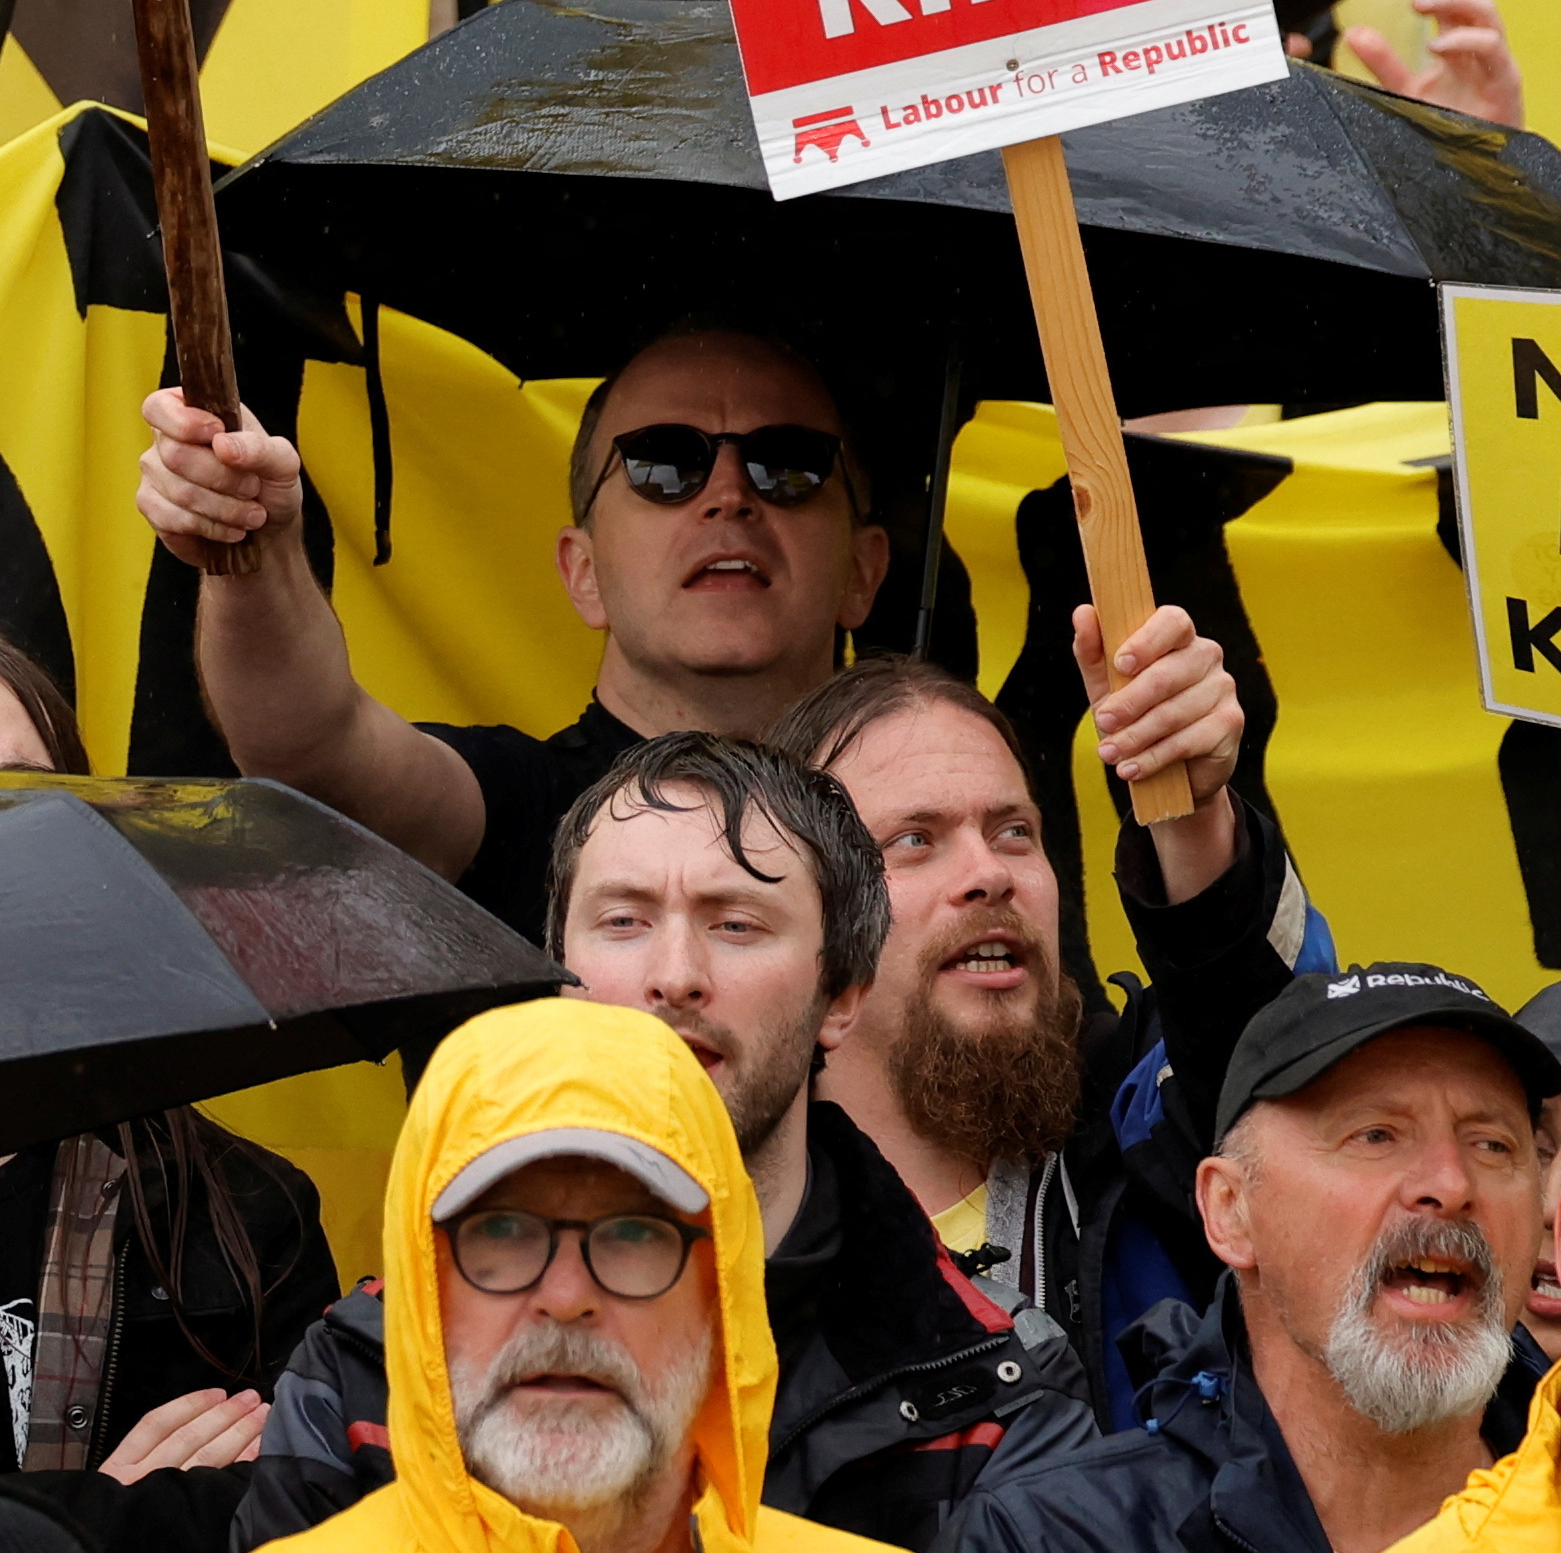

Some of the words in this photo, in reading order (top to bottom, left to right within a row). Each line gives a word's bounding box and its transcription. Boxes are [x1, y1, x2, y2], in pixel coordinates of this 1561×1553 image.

[881, 82, 1004, 131] Labour
[1014, 69, 1058, 95] for
[1072, 62, 1089, 85] a
[1098, 17, 1252, 78] Republic
